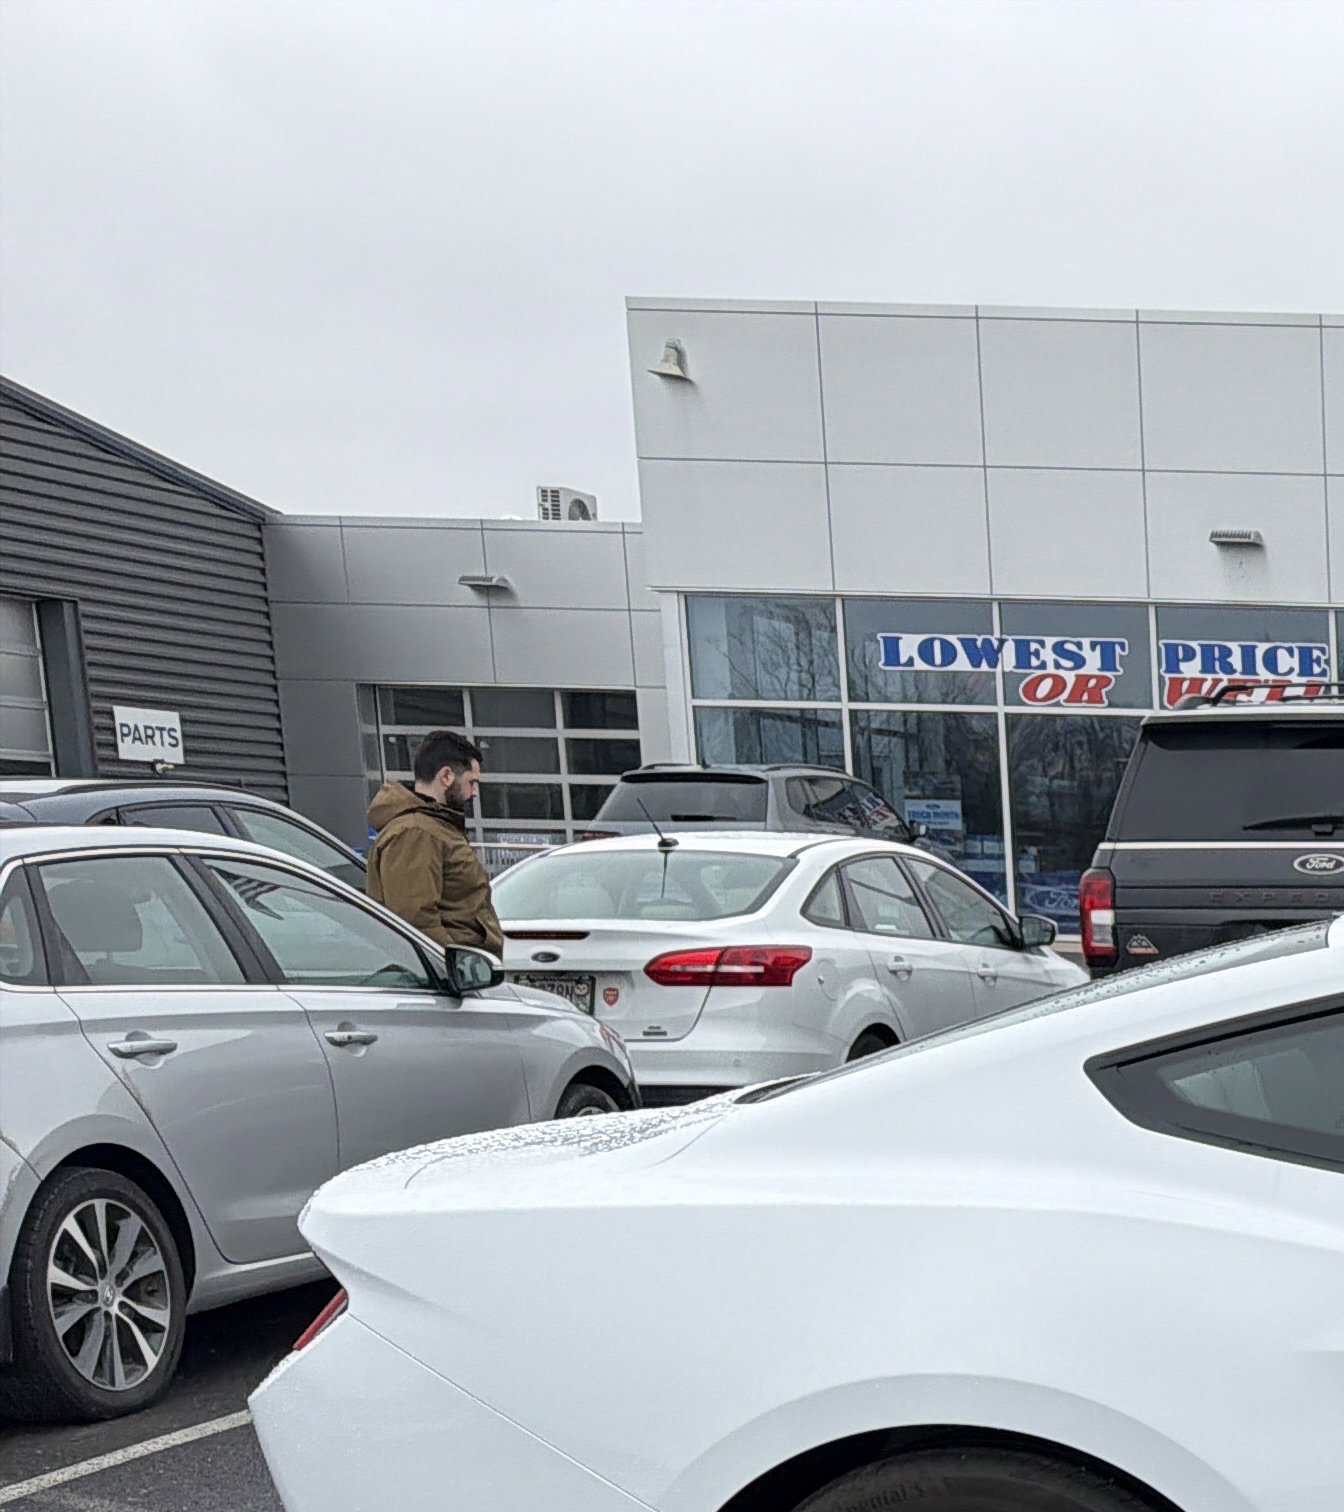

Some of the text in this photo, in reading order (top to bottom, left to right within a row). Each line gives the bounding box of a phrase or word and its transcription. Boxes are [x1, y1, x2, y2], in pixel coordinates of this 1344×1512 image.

[880, 635, 1127, 673] LOWEST
[1162, 642, 1328, 677] PRICE
[1022, 673, 1113, 704] OR
[119, 723, 180, 748] PARTS
[1305, 857, 1336, 870] Ford
